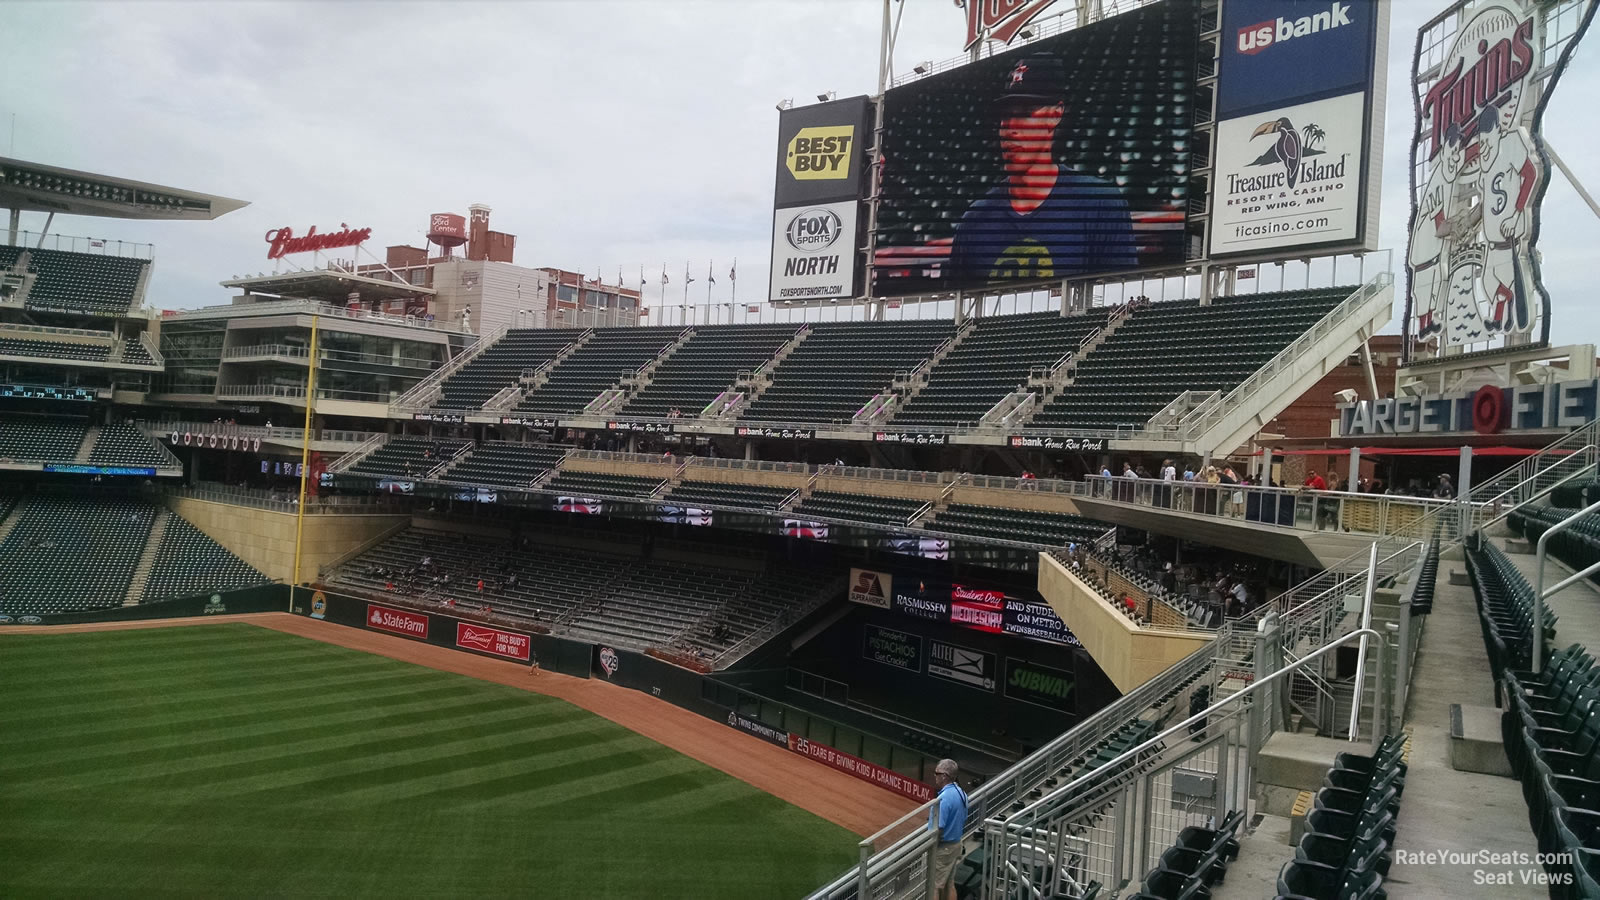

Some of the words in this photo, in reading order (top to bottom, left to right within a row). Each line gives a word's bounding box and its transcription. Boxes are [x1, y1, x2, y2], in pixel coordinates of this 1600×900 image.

[1423, 16, 1534, 162] Twins
[795, 136, 851, 154] BEST
[795, 154, 845, 171] BUY
[1227, 170, 1285, 195] Treasure
[1300, 153, 1346, 184] Island
[1227, 193, 1274, 206] RESORT
[1294, 183, 1345, 196] CASINO
[1241, 206, 1262, 214] RED
[1266, 200, 1302, 211] WING,
[1306, 196, 1326, 205] MN
[432, 215, 450, 226] Ford
[434, 225, 458, 233] Center
[798, 215, 831, 237] FOX
[1236, 217, 1329, 237] ticasino.com
[265, 222, 372, 259] Budweiser
[797, 234, 831, 245] SPORTS
[784, 255, 840, 277] NORTH
[780, 285, 842, 297] FOXSPORTSNORTH.COM
[1336, 391, 1467, 435] TARGET
[850, 592, 888, 606] SUPERAMERICA
[897, 594, 947, 613] RASMUSSEN
[955, 586, 984, 601] Student
[985, 592, 1002, 608] Day
[904, 606, 938, 619] COLLEGE
[1006, 601, 1025, 612] AND
[951, 604, 1003, 629] WEDNESDAY
[1017, 613, 1031, 624] ON
[1031, 615, 1062, 630] METRO
[465, 631, 491, 644] Budweiser
[497, 633, 509, 644] THIS
[509, 635, 526, 647] BUD'S
[496, 643, 507, 653] FOR
[507, 645, 520, 656] YOU.
[869, 636, 916, 658] PISTACHIOS
[875, 651, 886, 661] Get
[931, 642, 953, 662] ALTEC
[608, 655, 618, 671] 29
[652, 686, 661, 696] 377
[1008, 668, 1075, 698] SUBWAY
[738, 717, 752, 730] TWINS
[751, 722, 776, 739] COMMUNITY
[775, 731, 787, 744] FUND
[797, 737, 809, 755] 25
[809, 743, 827, 760] YEARS
[827, 750, 836, 762] OF
[836, 754, 856, 771] GIVING
[856, 760, 870, 777] KIDS
[871, 768, 876, 780] A
[877, 770, 902, 790] CHANCE
[903, 780, 912, 793] TO
[912, 784, 931, 801] PLAY.
